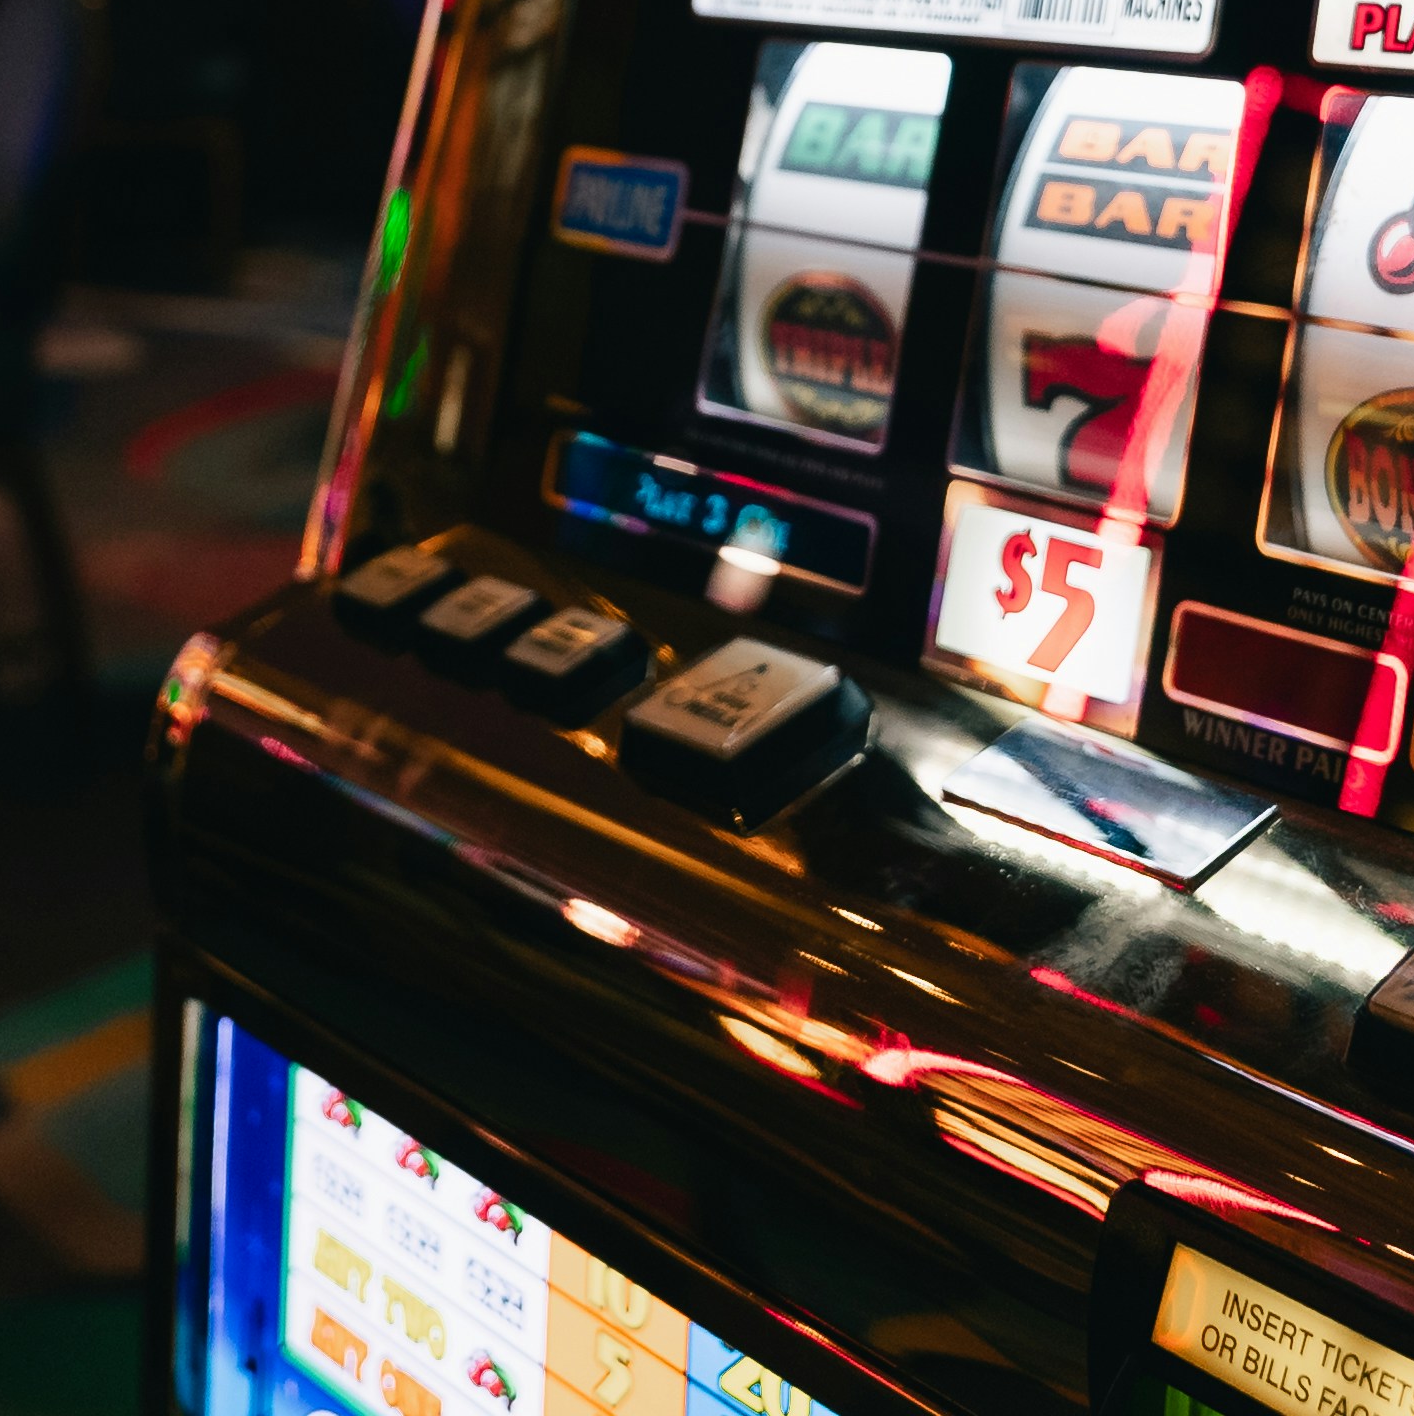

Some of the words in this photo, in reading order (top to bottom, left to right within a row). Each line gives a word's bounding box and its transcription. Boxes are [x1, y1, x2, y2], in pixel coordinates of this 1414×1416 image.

[1059, 120, 1235, 174] BAR
[1037, 182, 1217, 241] BAR
[996, 526, 1103, 672] $5
[1287, 605, 1323, 626] ONLY
[1328, 615, 1391, 643] HIGHES
[1293, 587, 1327, 608] PAYS
[1332, 598, 1353, 614] ON
[1183, 709, 1288, 767] WINNER
[1221, 1289, 1313, 1356] INSERT
[1201, 1324, 1238, 1364] OR
[1242, 1346, 1312, 1403] BILLS
[1317, 1386, 1381, 1416] FAC
